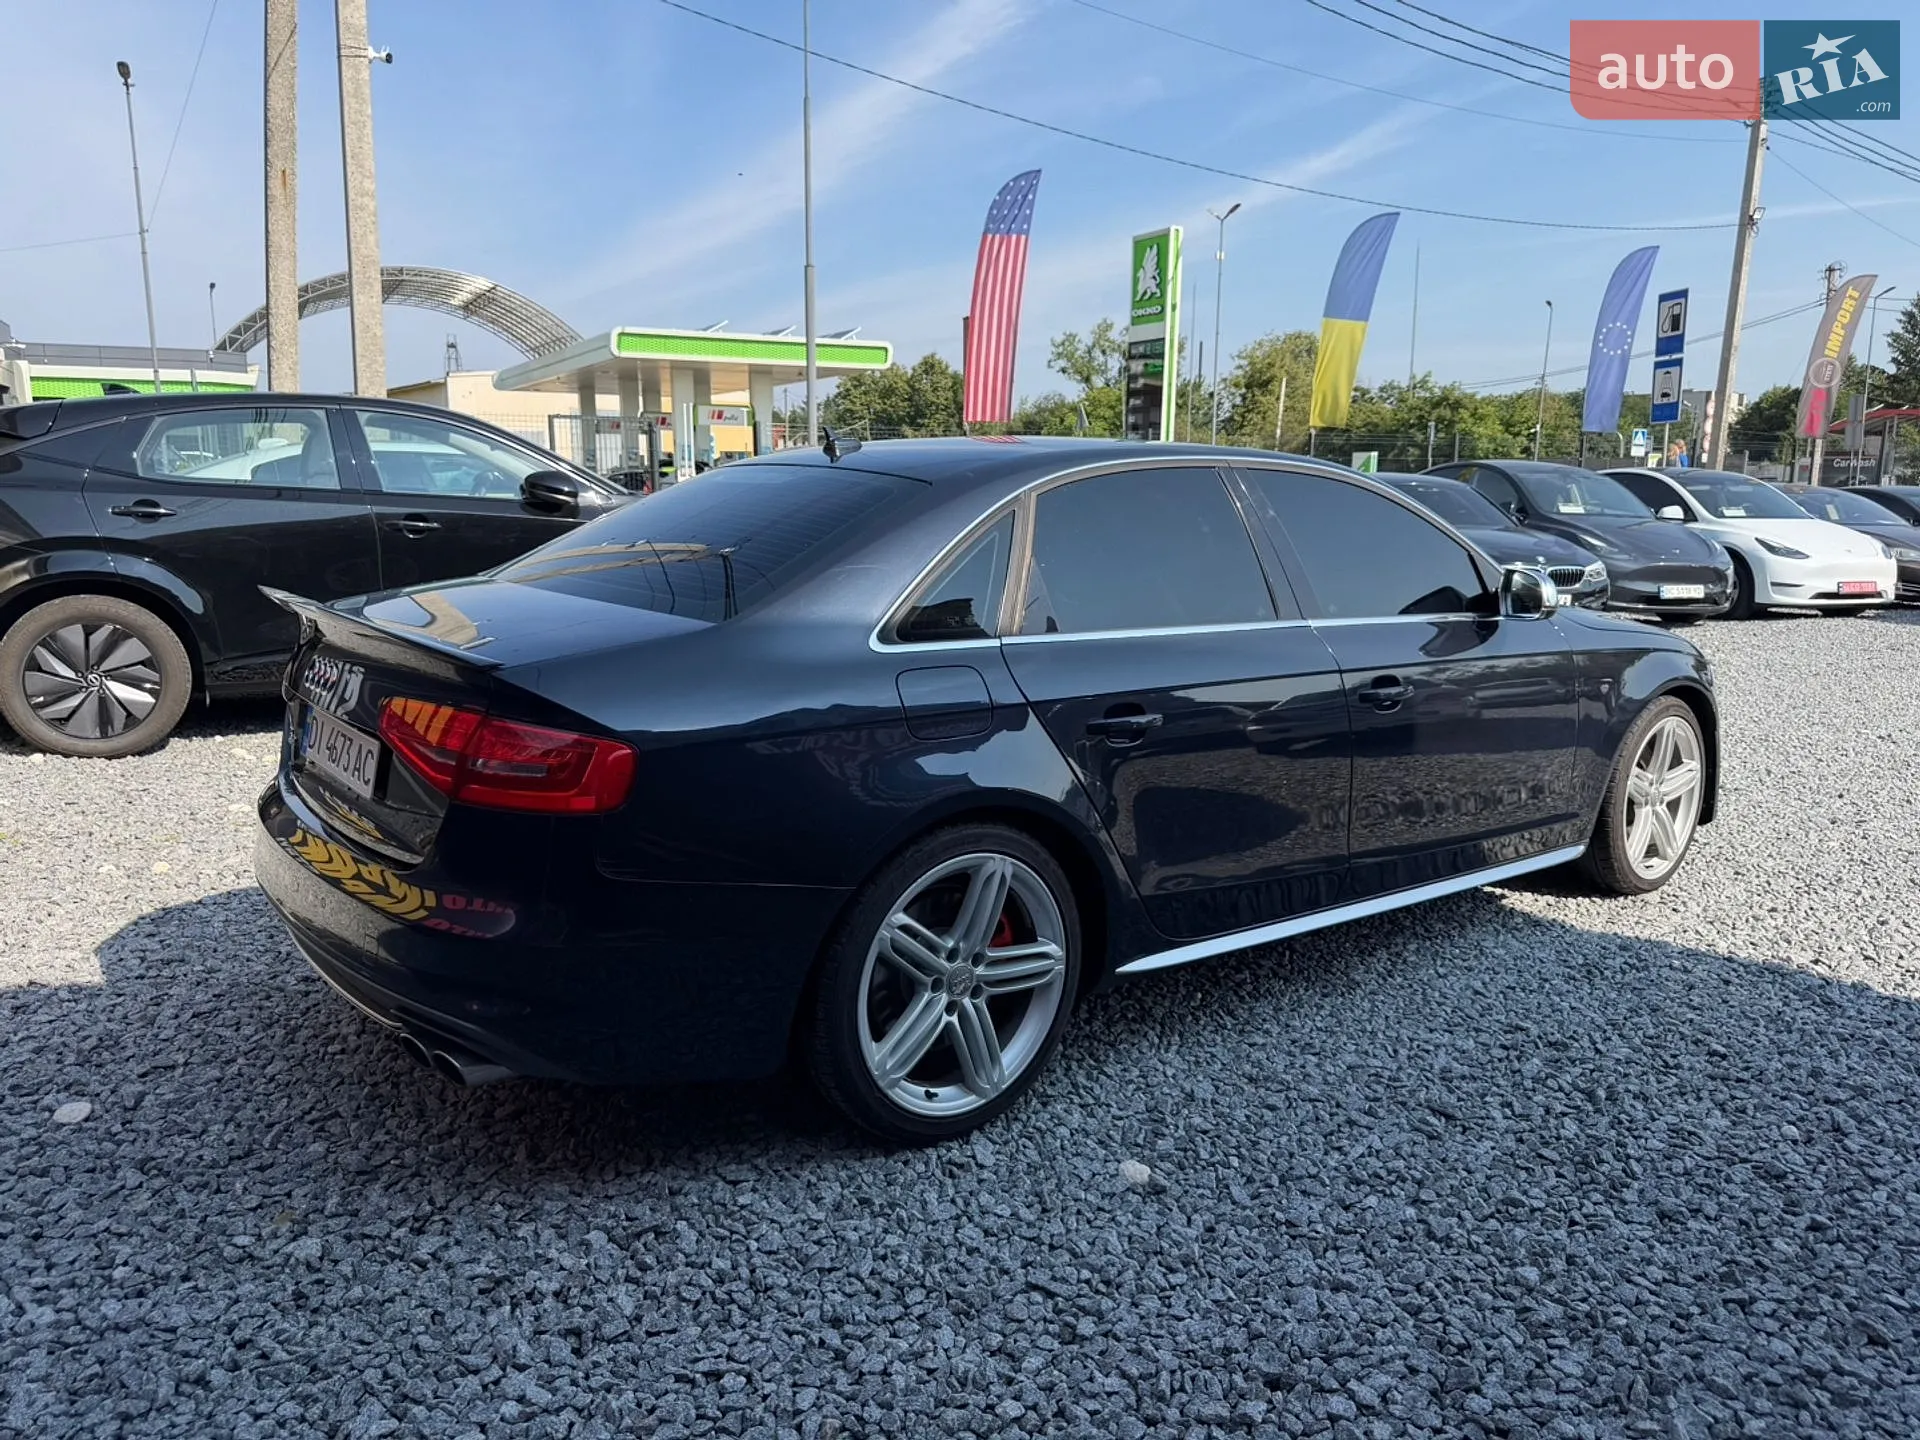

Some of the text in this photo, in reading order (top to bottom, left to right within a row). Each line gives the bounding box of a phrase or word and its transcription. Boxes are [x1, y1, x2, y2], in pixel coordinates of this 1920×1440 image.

[1823, 286, 1860, 359] IMPORT
[308, 715, 375, 786] DI 4673 AC
